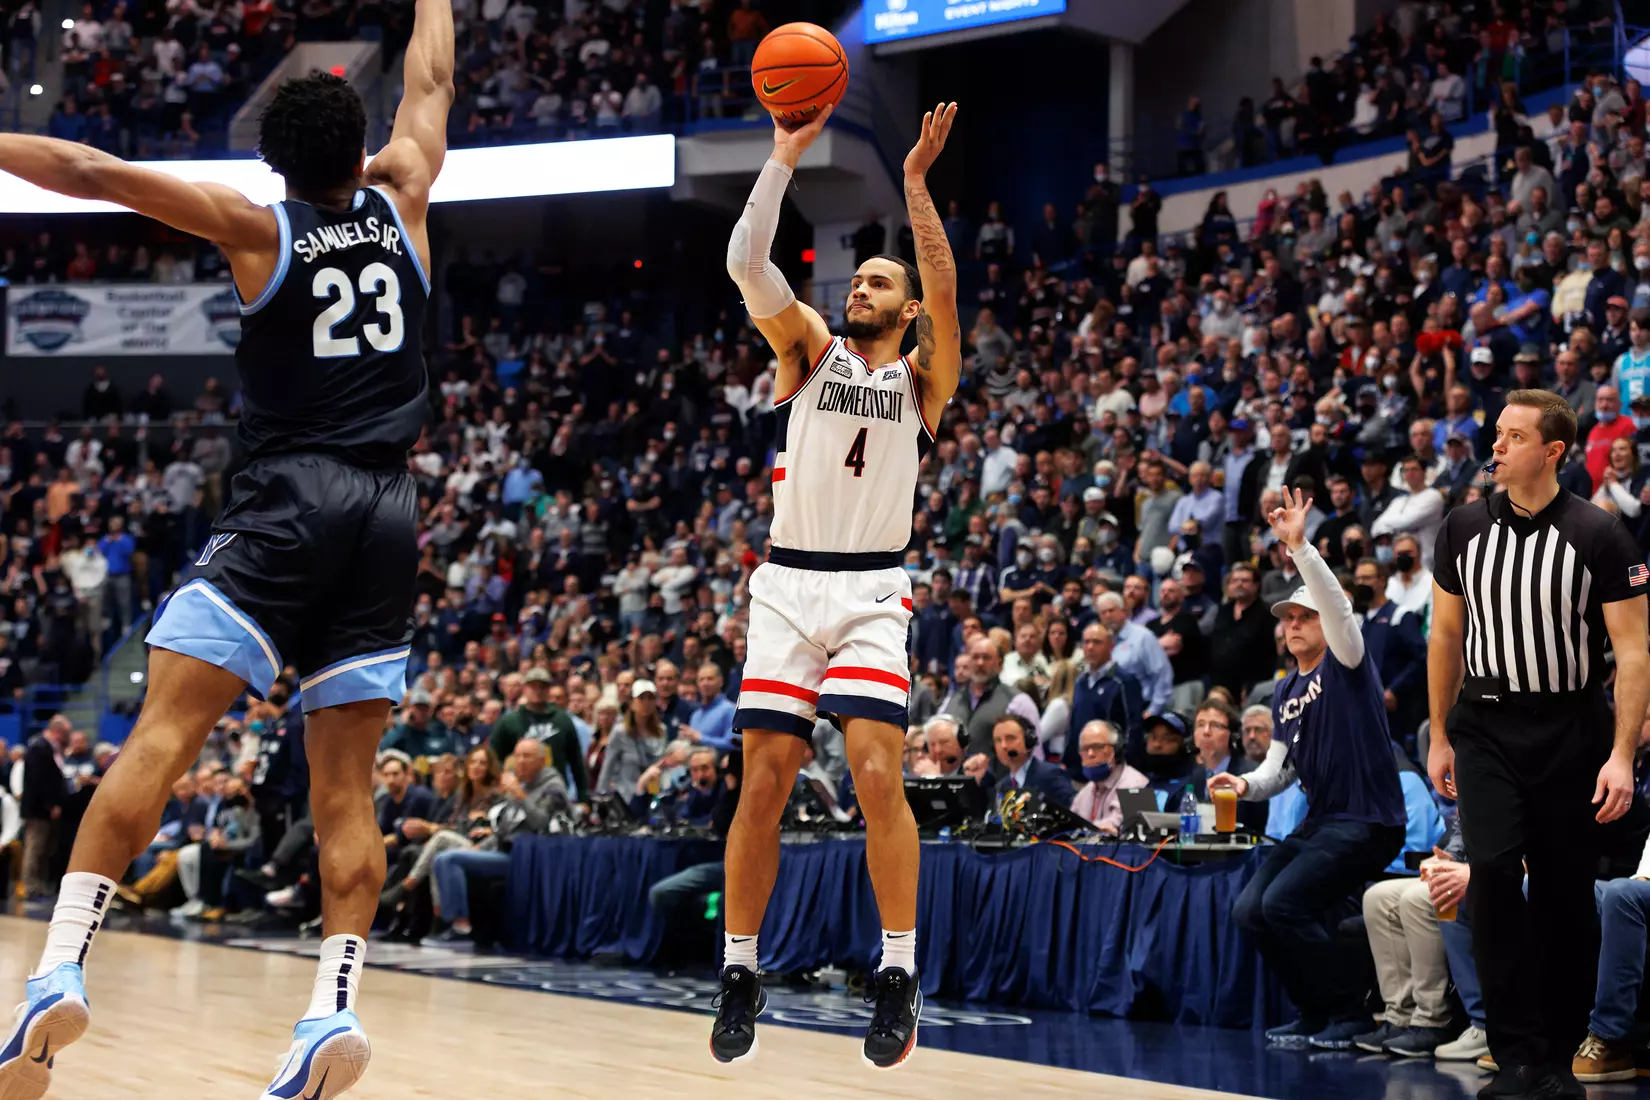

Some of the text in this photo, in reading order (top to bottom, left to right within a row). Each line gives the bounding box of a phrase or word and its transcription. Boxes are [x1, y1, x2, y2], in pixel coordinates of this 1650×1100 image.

[944, 3, 987, 20] EVENT
[293, 216, 404, 264] SAMUELS JR.
[312, 262, 406, 359] 23
[882, 372, 903, 381] EAST
[816, 380, 904, 424] CONNECTICUT
[844, 427, 869, 478] 4
